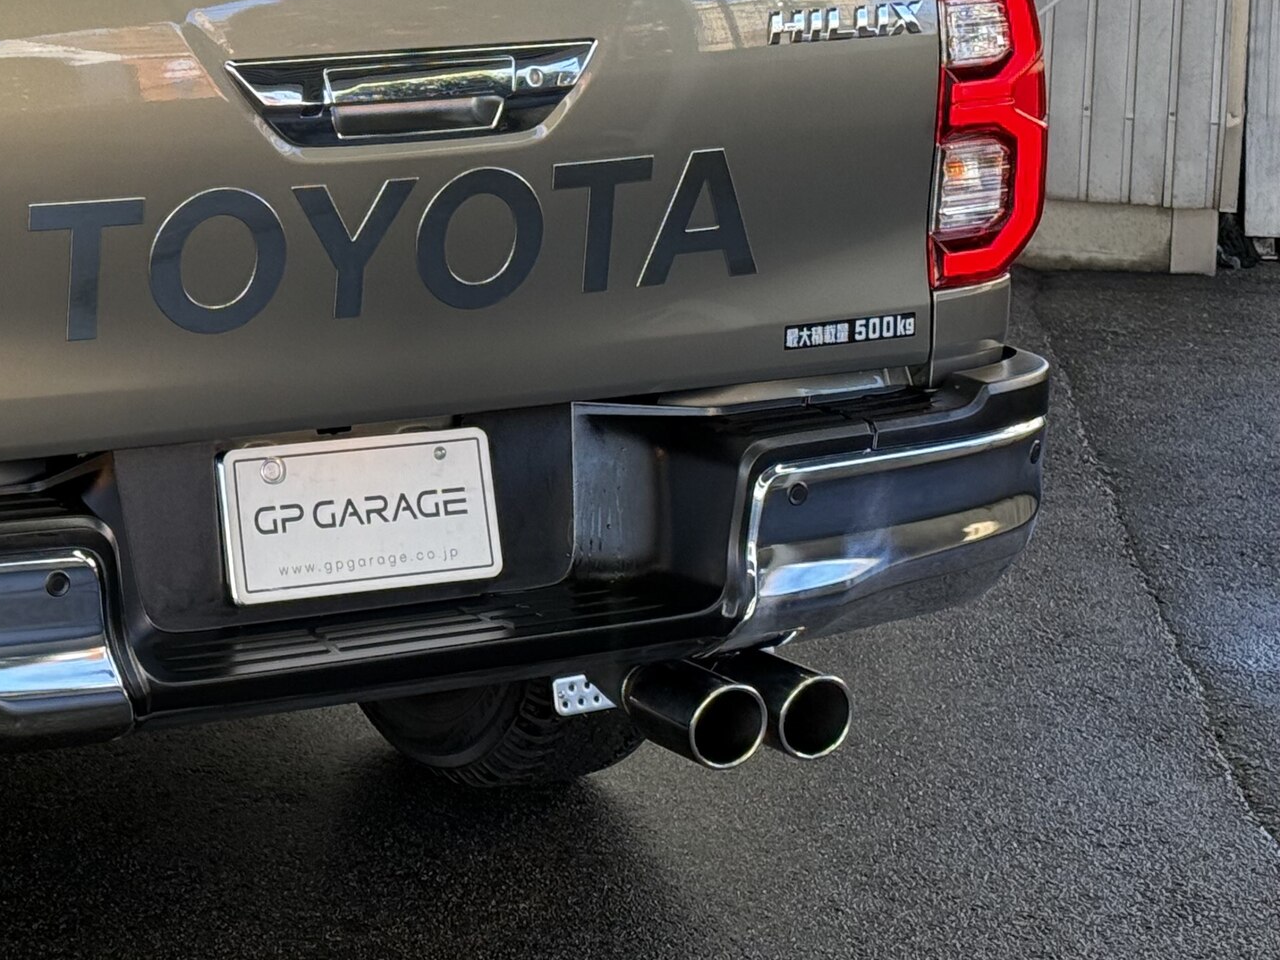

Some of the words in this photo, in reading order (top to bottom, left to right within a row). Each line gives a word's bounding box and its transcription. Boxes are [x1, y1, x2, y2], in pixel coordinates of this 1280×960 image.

[768, 0, 923, 45] HILUX
[28, 147, 758, 341] TOYOTA
[854, 315, 915, 341] 500kg
[253, 503, 305, 536] GP
[312, 486, 469, 530] GARAGE
[279, 547, 458, 576] www.gpgarage.co.jp
